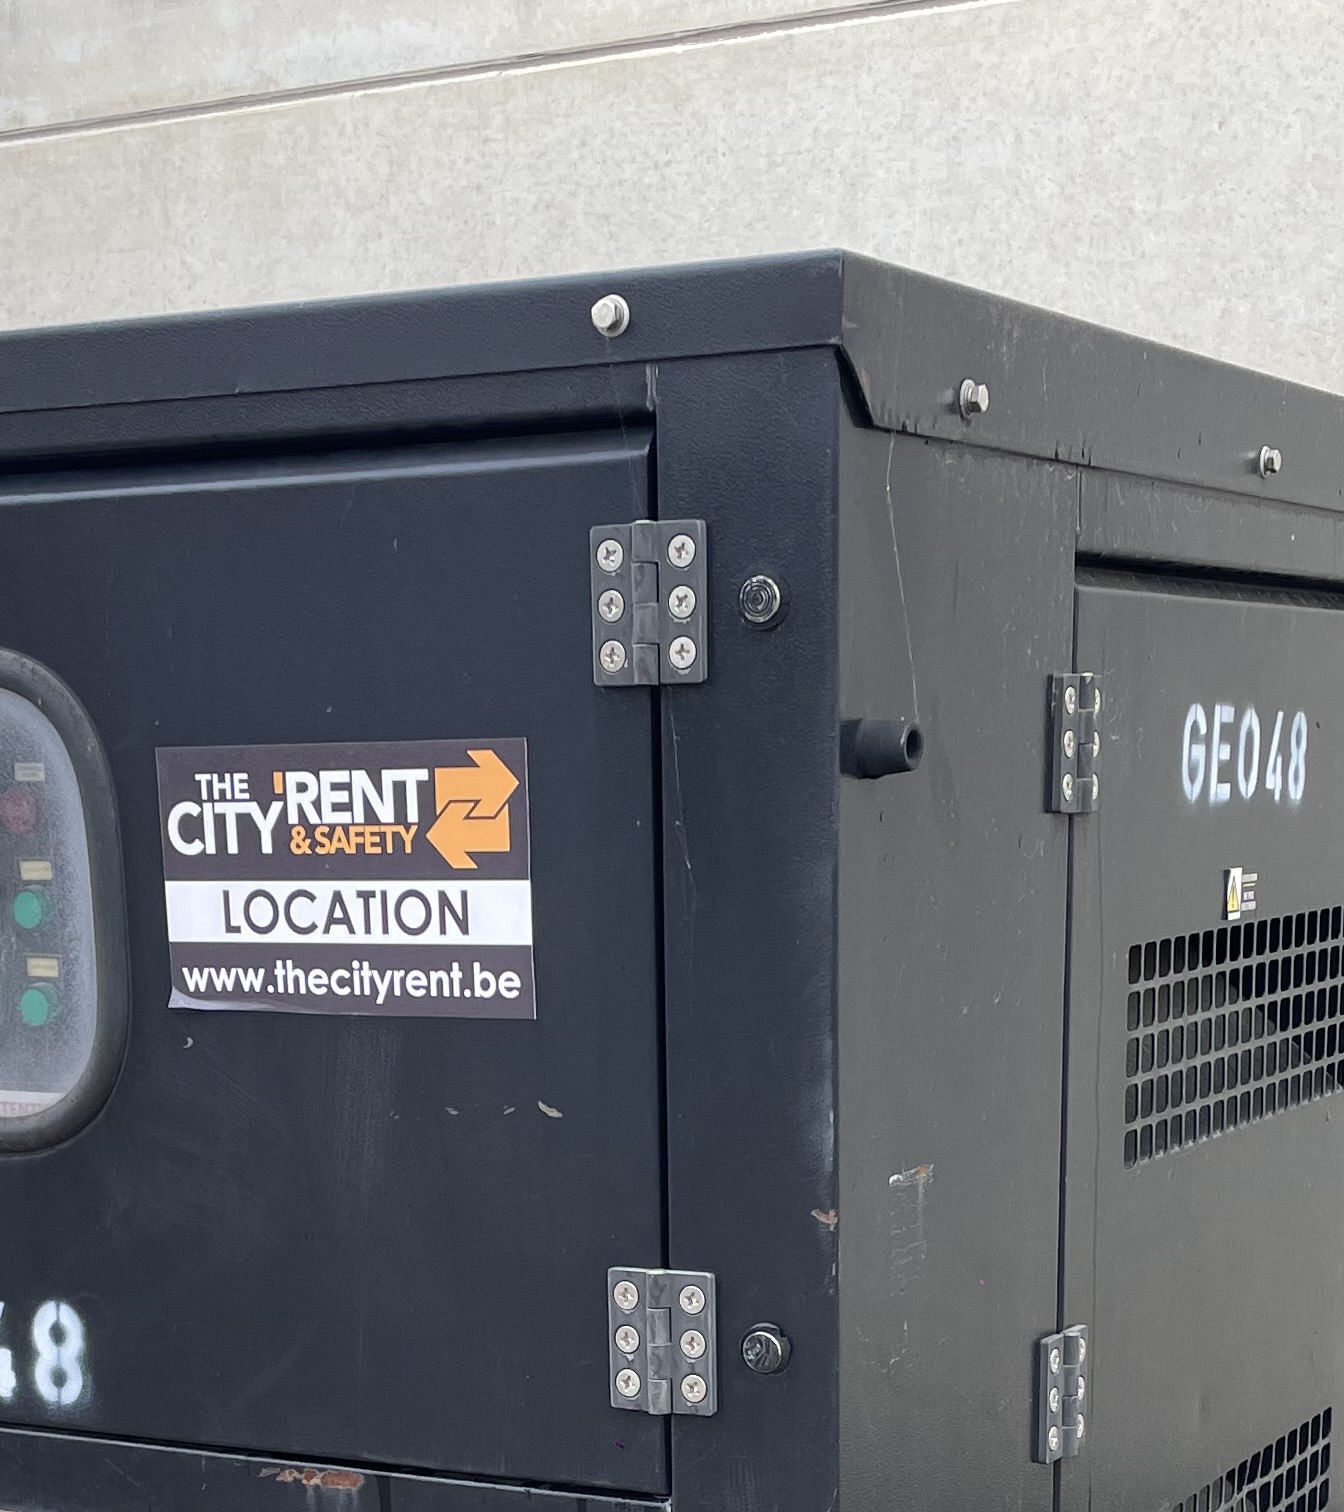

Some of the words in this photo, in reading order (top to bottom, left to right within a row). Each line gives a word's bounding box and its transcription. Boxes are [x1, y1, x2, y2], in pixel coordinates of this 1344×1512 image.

[194, 772, 250, 800] THE
[167, 800, 284, 856] CITY
[289, 829, 312, 855] &
[314, 824, 418, 855] SAFETY
[222, 888, 470, 936] LOCATION
[181, 959, 522, 1005] www.thecityrent.be
